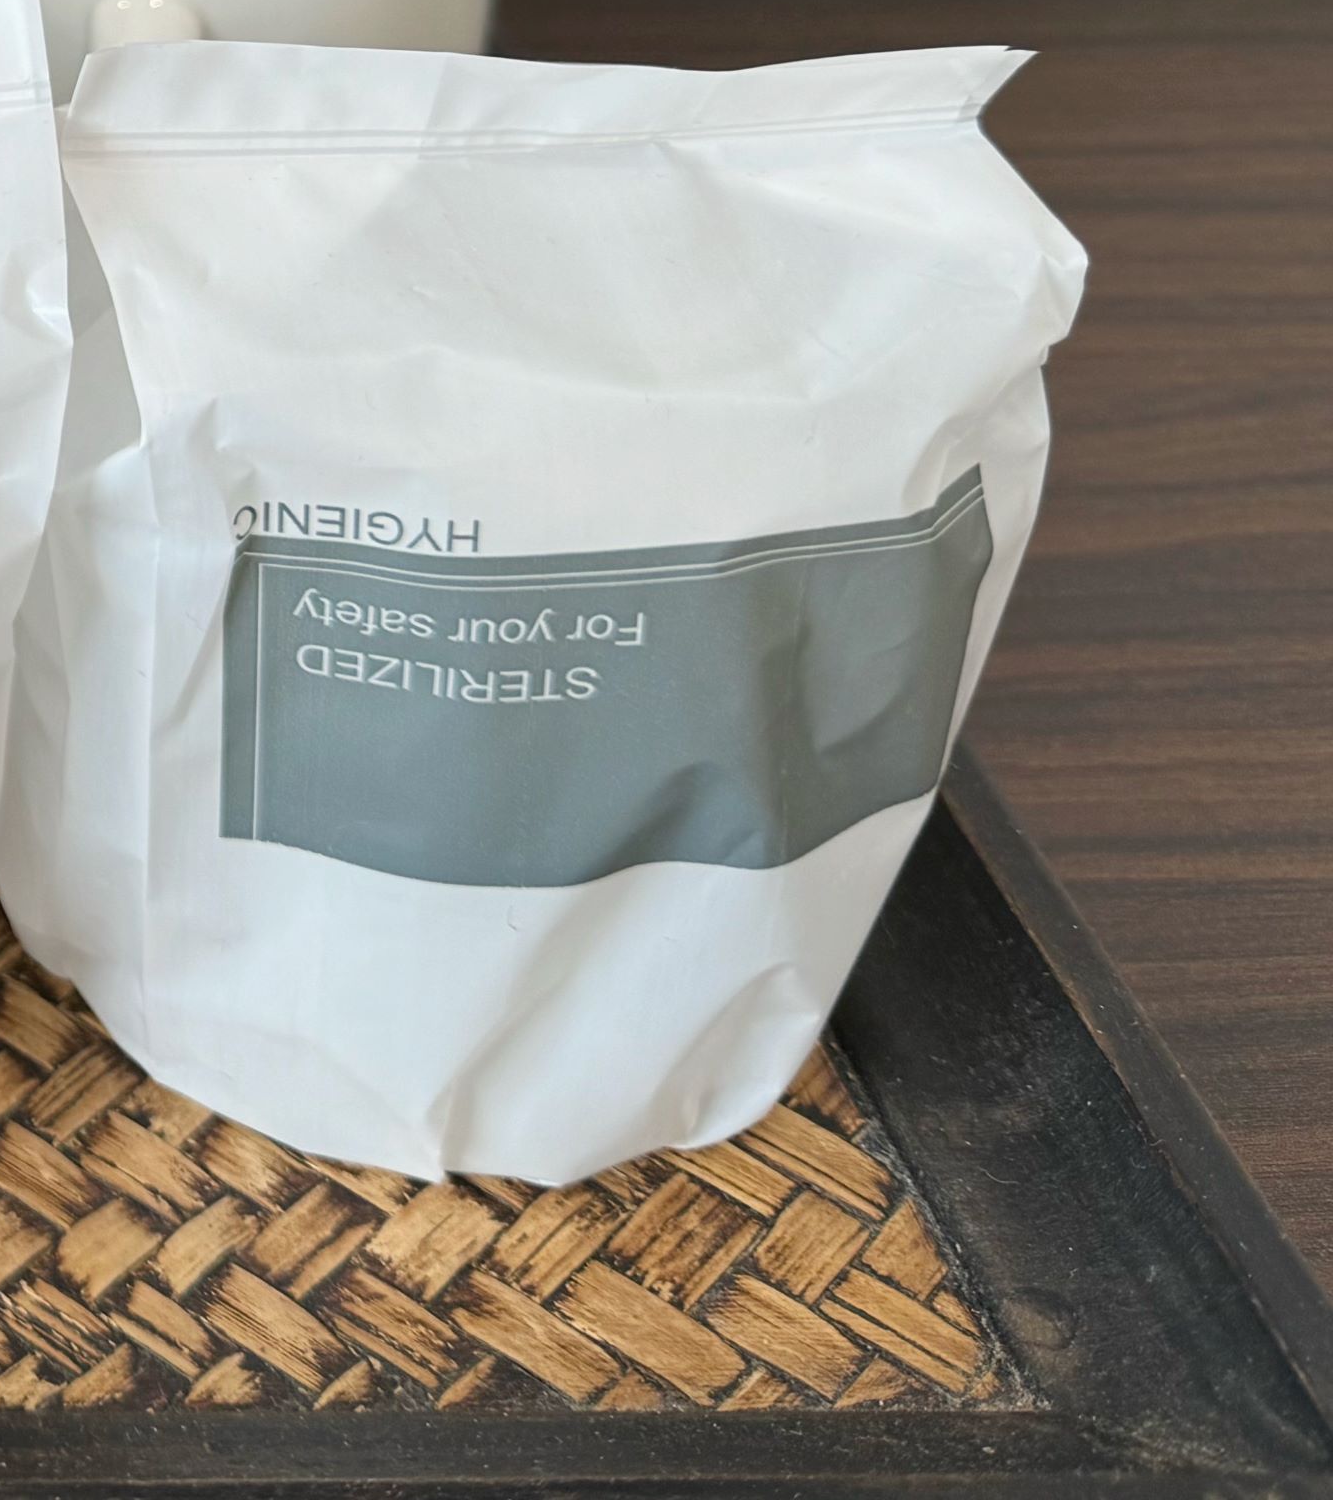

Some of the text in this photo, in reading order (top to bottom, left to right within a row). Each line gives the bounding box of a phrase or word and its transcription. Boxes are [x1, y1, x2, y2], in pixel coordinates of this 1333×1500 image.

[233, 501, 481, 554] HYGIENIC
[292, 588, 645, 647] For your safety
[296, 643, 601, 703] STERILIZED
